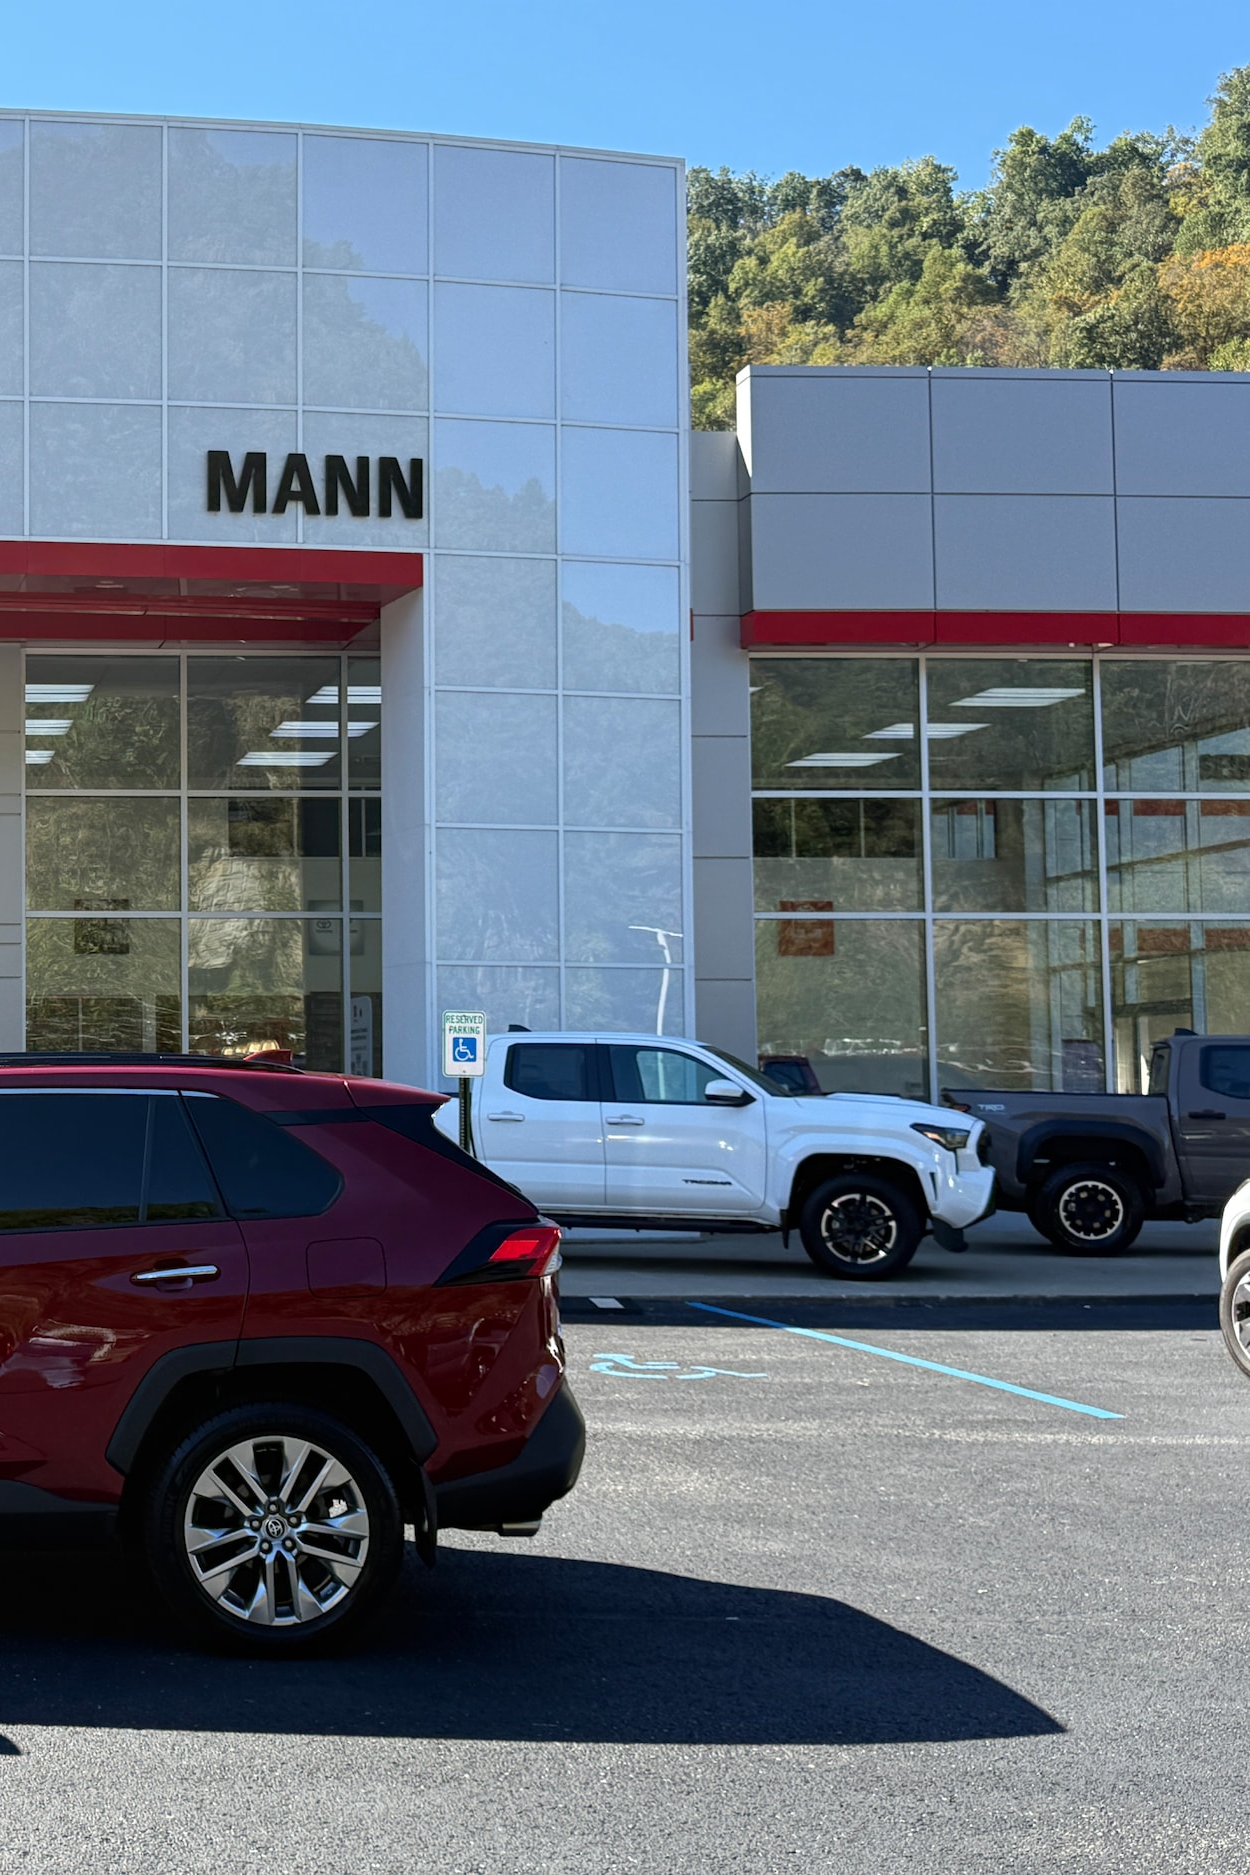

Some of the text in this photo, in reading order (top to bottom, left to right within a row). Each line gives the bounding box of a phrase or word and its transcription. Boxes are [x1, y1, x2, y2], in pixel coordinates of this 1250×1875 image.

[207, 450, 424, 519] MANN
[445, 1014, 483, 1024] RESERVED
[449, 1025, 480, 1034] PARKING
